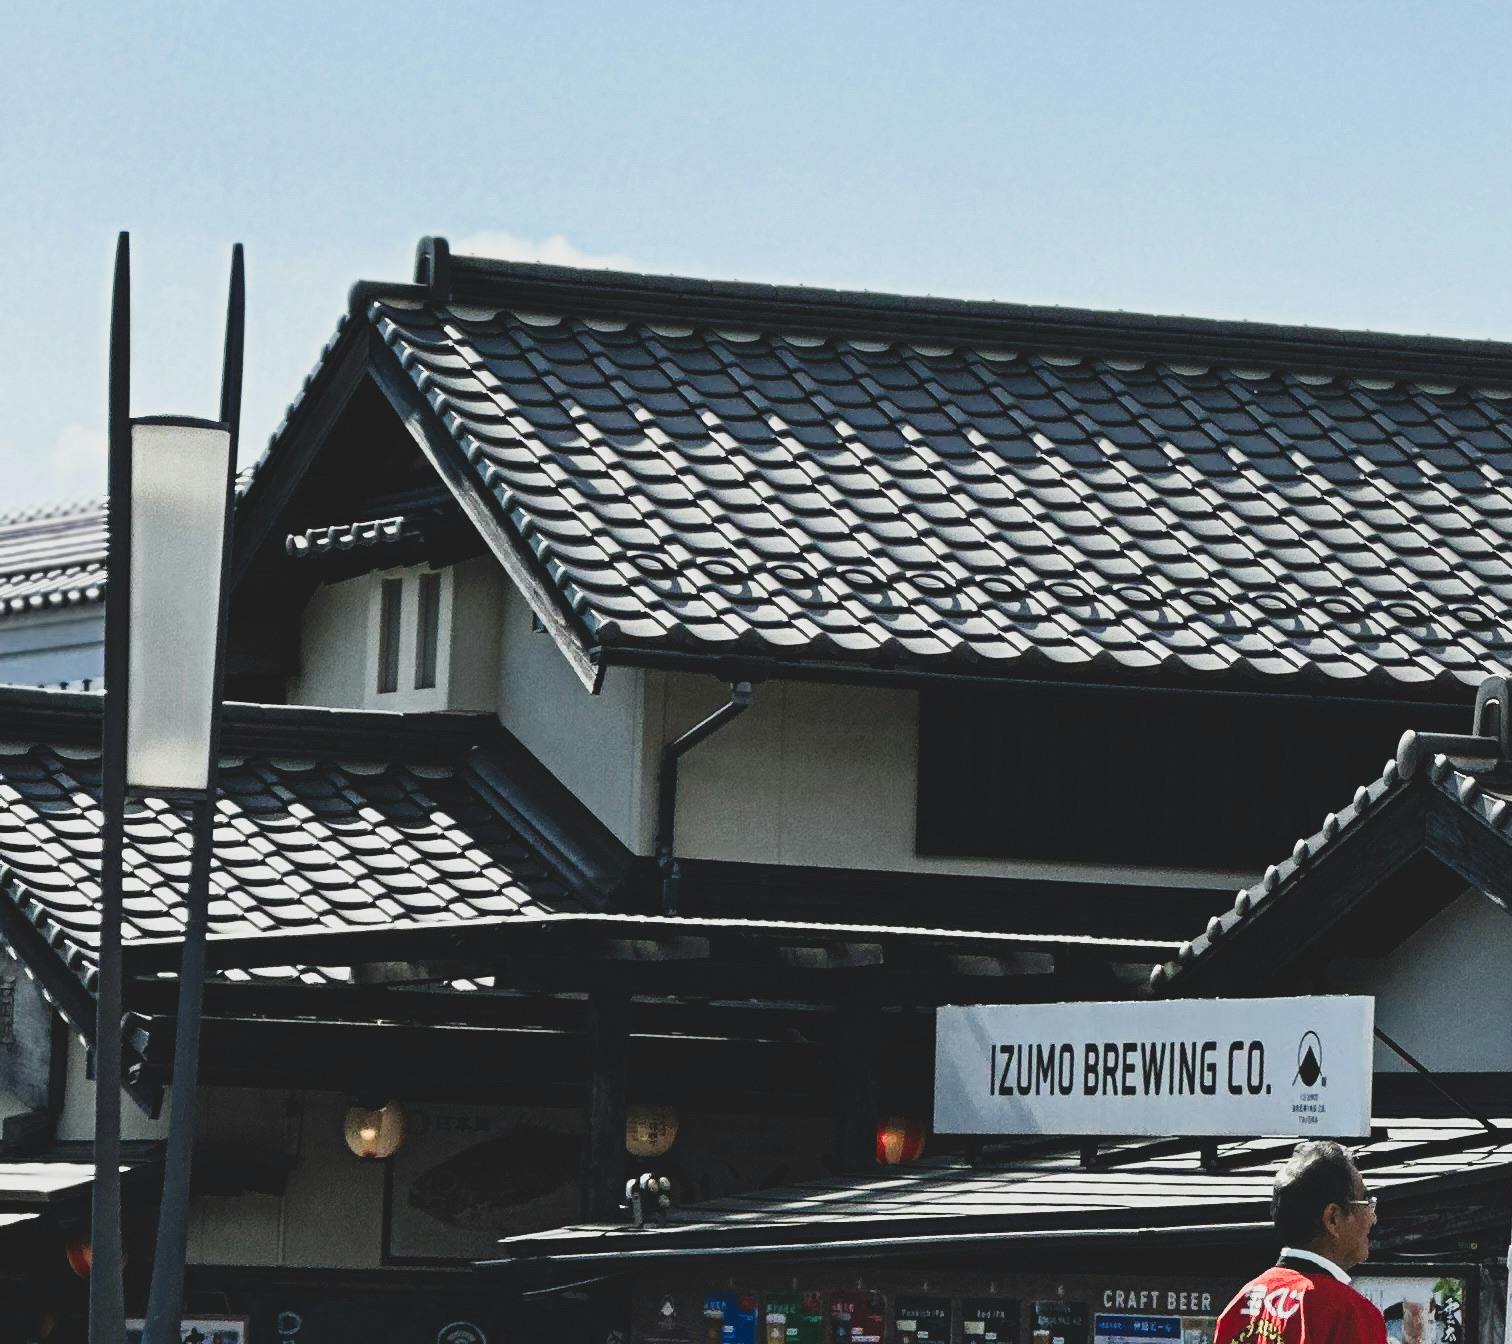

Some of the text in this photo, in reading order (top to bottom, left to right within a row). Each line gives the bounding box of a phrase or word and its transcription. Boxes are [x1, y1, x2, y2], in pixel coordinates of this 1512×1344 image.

[990, 1040, 1272, 1097] IZUMO BREWING CO.
[1103, 1289, 1211, 1311] CRAFT BEER
